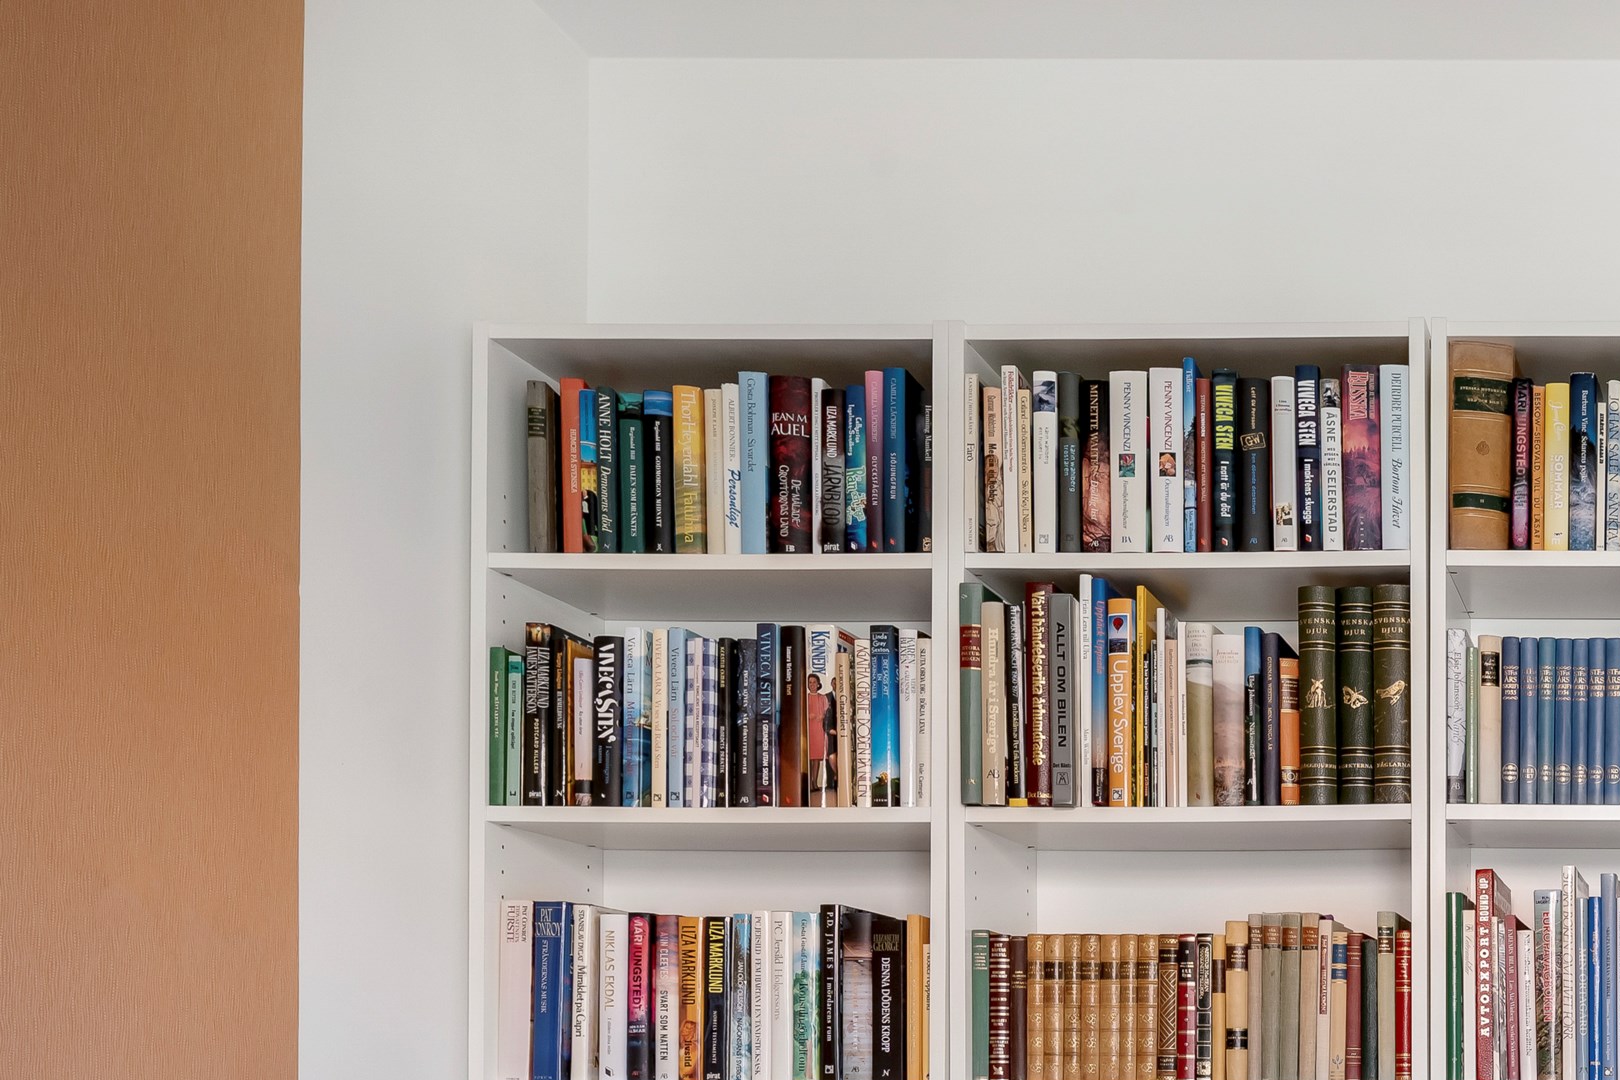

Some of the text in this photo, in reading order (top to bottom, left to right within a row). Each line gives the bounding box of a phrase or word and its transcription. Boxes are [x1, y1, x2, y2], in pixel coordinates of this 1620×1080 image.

[772, 413, 808, 423] JEAN M
[1123, 382, 1131, 451] PENNY VINCENZI
[1216, 385, 1233, 450] VIVECA STEN
[1298, 380, 1316, 445] VIVECA STEN
[1347, 371, 1368, 420] RUSSKA
[1392, 373, 1402, 452] DEIRDRE PURCELL
[598, 393, 612, 532] ANNE HOLT Demonens död
[771, 424, 810, 438] AUEL
[826, 419, 837, 458] MARKLUND
[678, 391, 696, 543] Thor Heyerdahl Fatuhiva
[726, 469, 740, 528] Personligt
[823, 462, 843, 525] JÄRNBLOD
[1326, 412, 1337, 532] ÅSNE SEIERSTAD
[526, 646, 537, 713] JAMES PATTERSON
[538, 647, 550, 708] LIZA MARKLUND
[760, 632, 771, 714] VIVECA STEN
[811, 631, 830, 675] KENNEDY
[1031, 591, 1046, 765] Vårt händelserika århundrade
[1056, 622, 1066, 747] ALLT OM BILEN
[1111, 660, 1128, 773] Upplev Sverige
[605, 930, 614, 1011] NIKLAS EKDAL
[682, 926, 695, 1004] LIZA MARKLUND
[709, 921, 723, 993] LIZA MARKLUND
[774, 921, 783, 964] PC Jersild
[1479, 878, 1489, 1037] AVTOEXPORT ROUND-UP
[660, 990, 668, 1060] SVART SOM NATTEN
[881, 957, 891, 1052] DENNA DÖDENS KROPP
